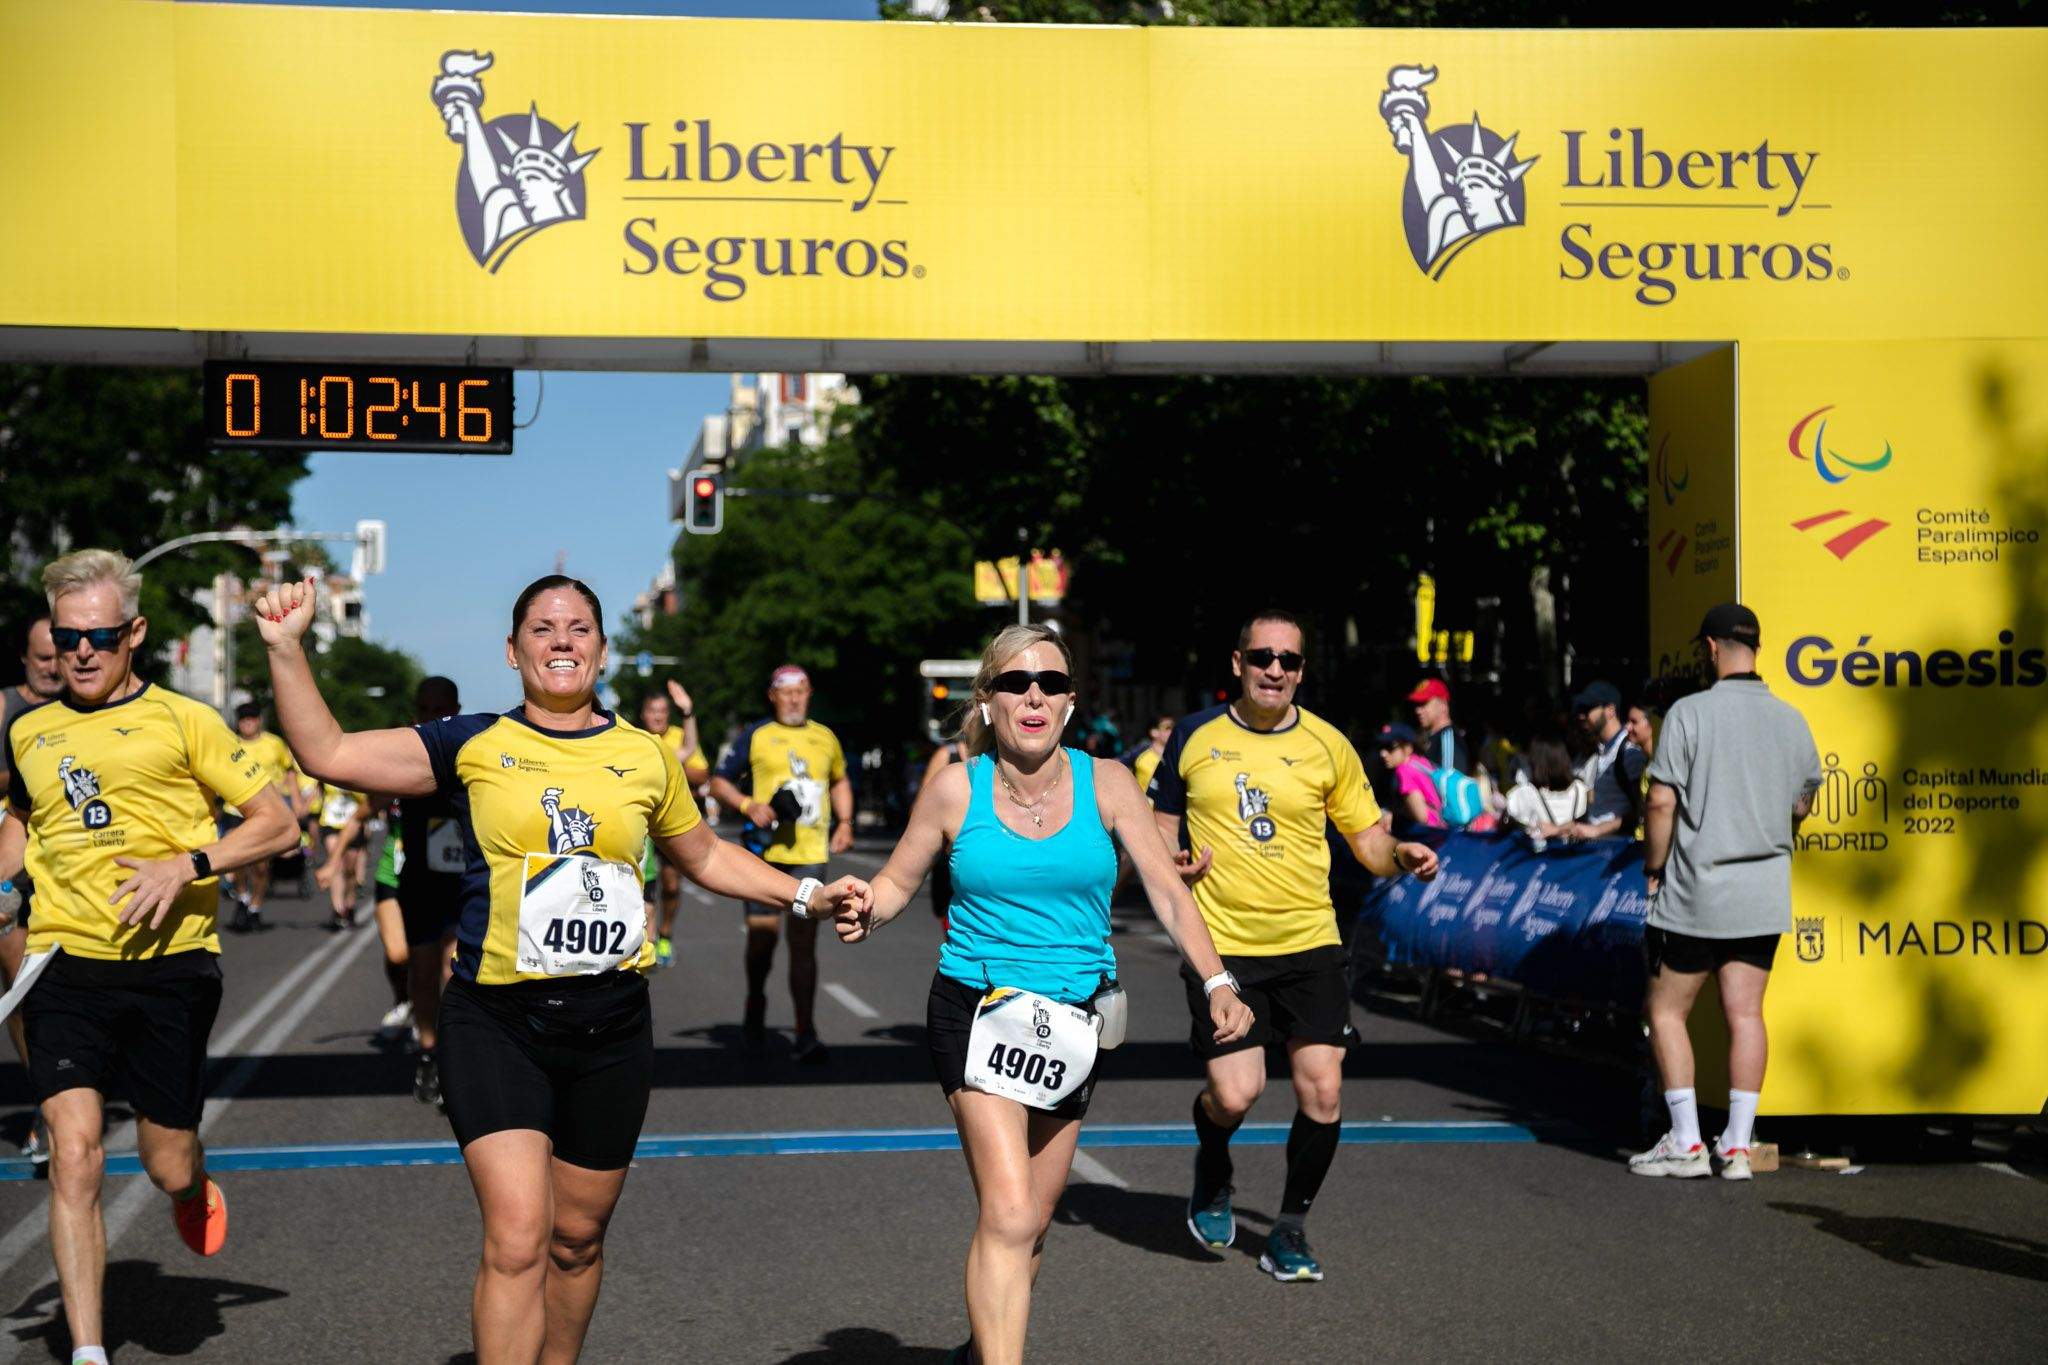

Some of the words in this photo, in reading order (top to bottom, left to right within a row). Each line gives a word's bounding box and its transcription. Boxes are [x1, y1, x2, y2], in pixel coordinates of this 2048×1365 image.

[622, 118, 896, 212] Liberty
[1560, 127, 1821, 217] Liberty
[622, 216, 909, 302] Seguros
[1560, 222, 1834, 307] Seguros
[226, 373, 260, 437] 0
[301, 375, 492, 442] 1:02:46
[1917, 508, 1990, 524] Comité
[1917, 526, 2040, 545] Paralímpico
[1918, 545, 1999, 565] Español
[1785, 629, 2048, 688] Génesis
[1902, 767, 1975, 789] Capital
[87, 805, 108, 825] 13
[1903, 792, 1933, 810] del
[1938, 792, 2020, 813] Deporte
[1255, 821, 1273, 837] 13
[1904, 817, 1955, 834] 2022
[93, 838, 126, 848] Liberty
[543, 917, 628, 956] 4902
[1858, 920, 2048, 956] MADRID
[987, 1042, 1067, 1091] 4903
